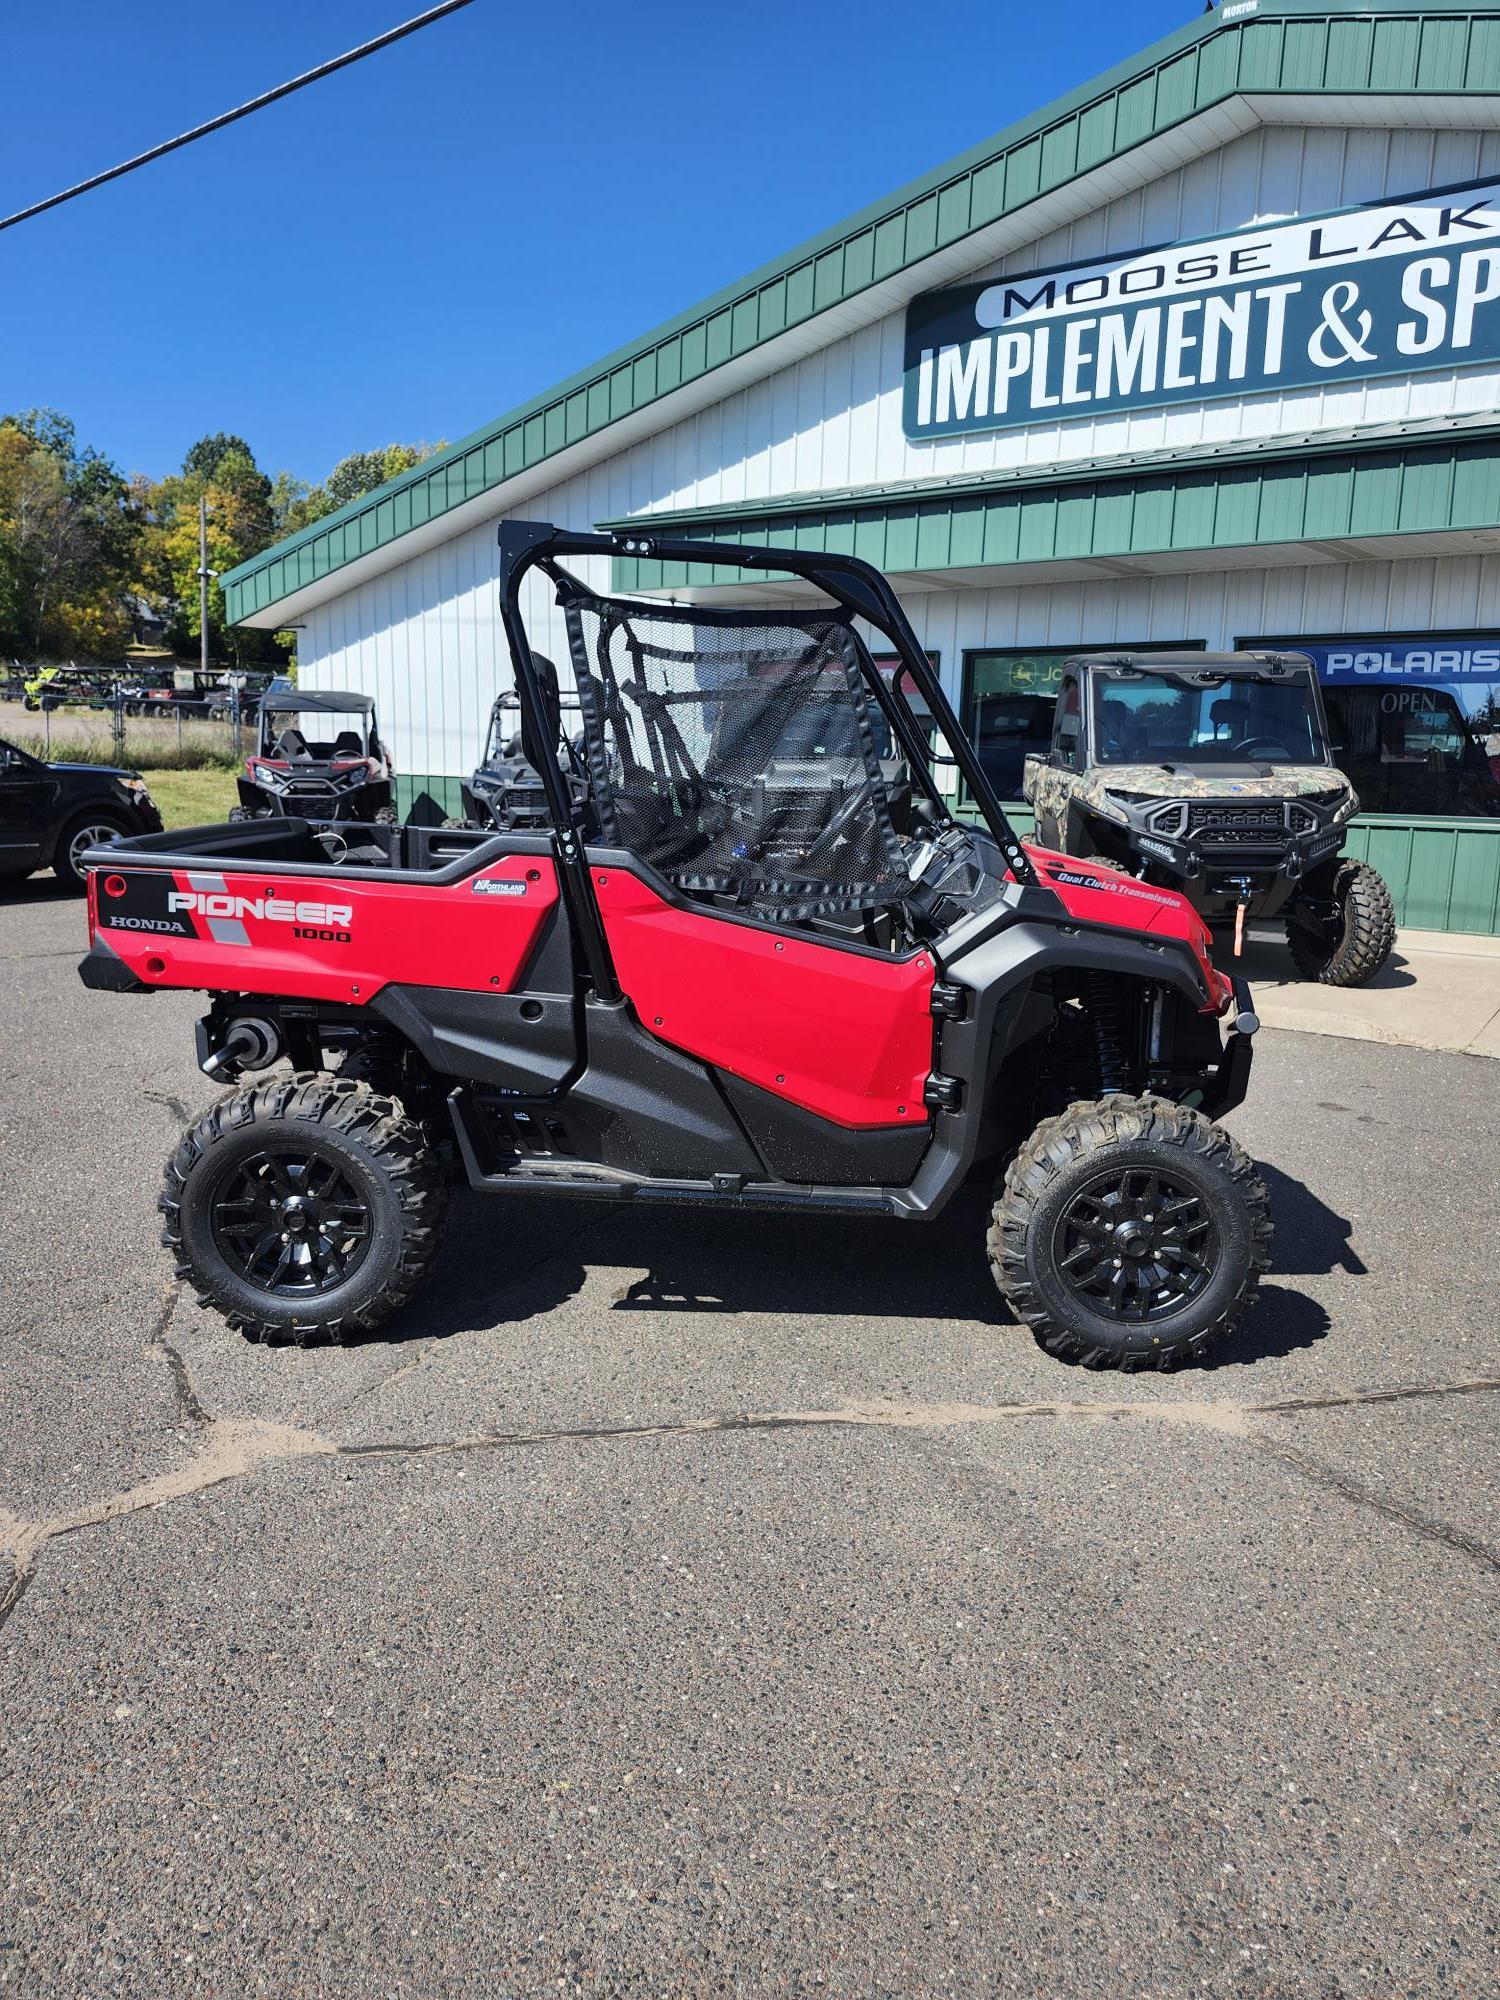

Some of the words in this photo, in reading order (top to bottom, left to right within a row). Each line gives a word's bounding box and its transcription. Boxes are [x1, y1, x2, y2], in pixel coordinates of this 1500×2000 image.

[1222, 1, 1258, 19] MORTON
[1002, 242, 1273, 319] MOOSE
[1308, 199, 1496, 261] LAK
[917, 282, 1302, 426] IMPLEMENT
[1307, 281, 1378, 368] &
[1396, 247, 1500, 355] SP
[1326, 650, 1500, 675] POLARIS
[1380, 692, 1436, 713] OPEN
[1192, 814, 1278, 826] POLARIS
[473, 880, 526, 891] NORTHLAND
[1057, 872, 1084, 884] Dual
[1084, 877, 1118, 892] Clutch
[1119, 884, 1181, 908] Transmission
[168, 891, 353, 928] PIONEER
[109, 915, 187, 933] HONDA
[292, 927, 352, 943] 1000
